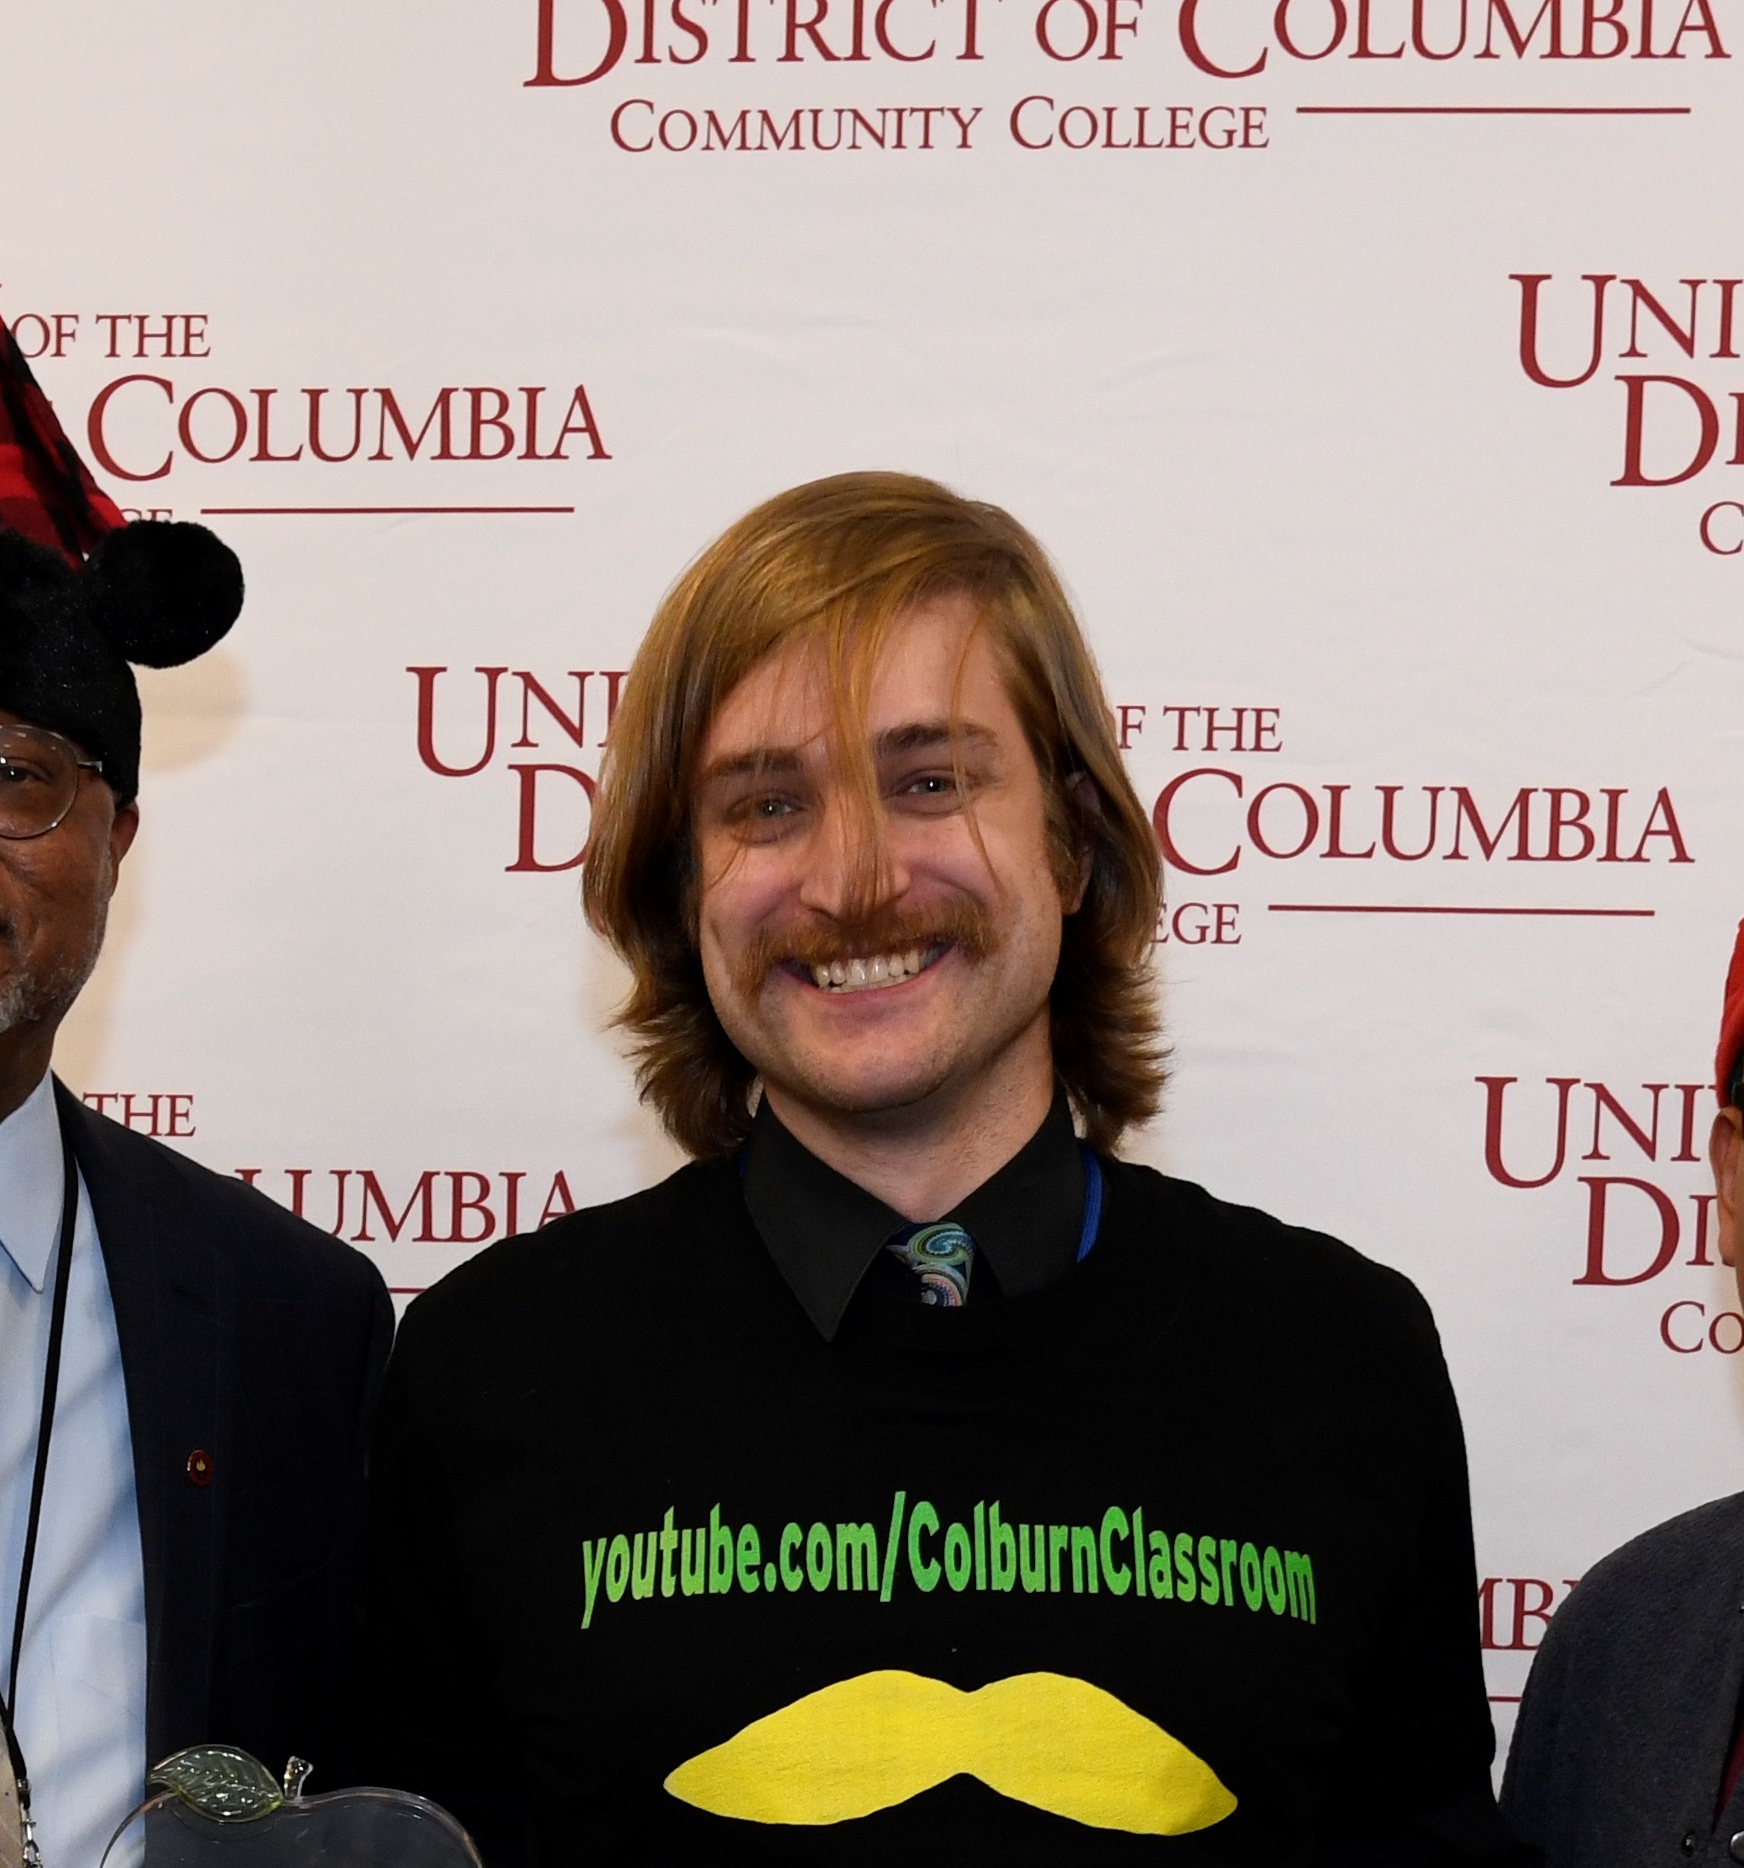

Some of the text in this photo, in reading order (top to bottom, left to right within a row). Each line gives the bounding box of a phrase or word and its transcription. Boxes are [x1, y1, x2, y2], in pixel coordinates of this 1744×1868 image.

[523, 0, 1730, 87] DISTRICT OF COLUMBIA
[610, 95, 1270, 153] COMMUNITY COLLEGE
[11, 314, 80, 358] OF
[95, 314, 211, 359] THE
[87, 374, 611, 482] COLUMBIA
[1162, 705, 1283, 753] THE
[1152, 767, 1693, 876] COLUMBIA
[82, 1092, 197, 1137] THE
[580, 1490, 1318, 1631] youtube.com/ColburnClassroom
